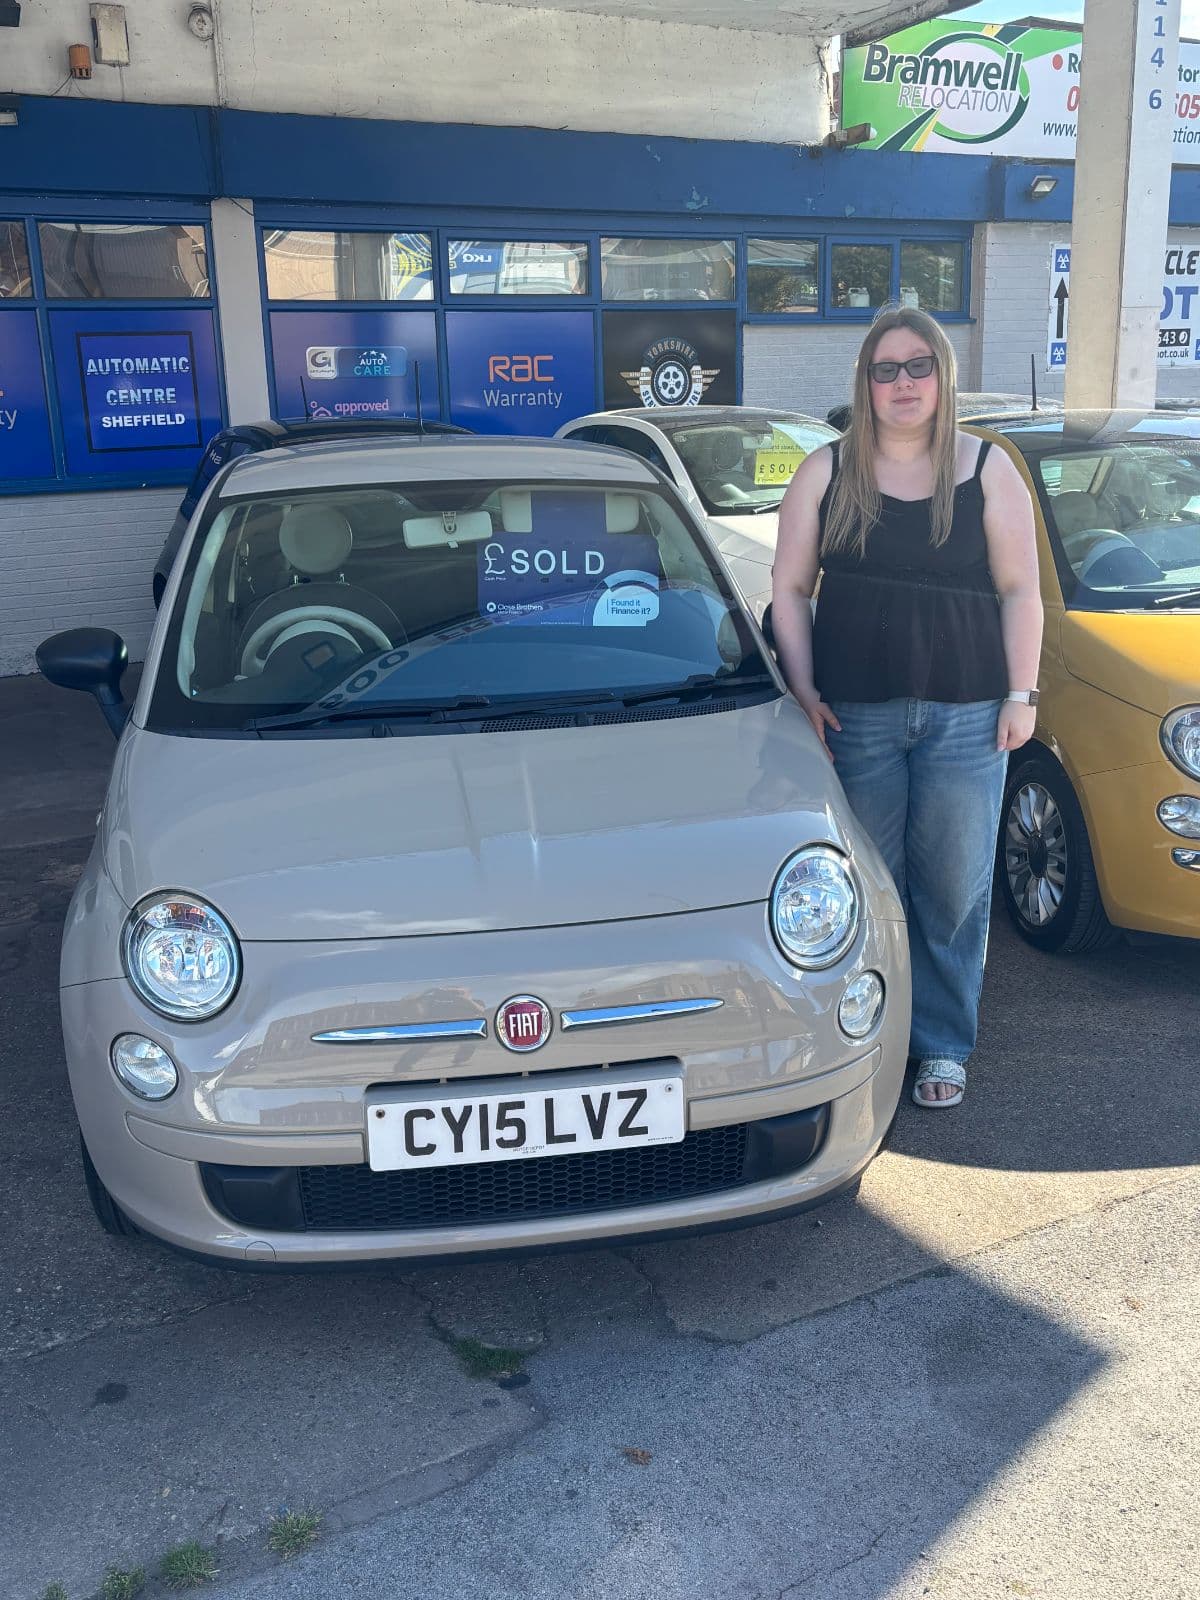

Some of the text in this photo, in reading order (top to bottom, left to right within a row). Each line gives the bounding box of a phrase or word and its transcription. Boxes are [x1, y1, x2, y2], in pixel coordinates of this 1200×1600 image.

[863, 43, 1023, 91] Bramwell
[898, 86, 1013, 113] RELOCATION
[1164, 250, 1200, 275] CLE
[647, 340, 696, 359] YORKSHIRE
[87, 357, 190, 375] AUTOMATIC
[353, 366, 391, 375] CARE
[360, 358, 384, 366] AUTO
[106, 388, 177, 405] CENTRE
[483, 388, 562, 408] Warranty
[334, 399, 389, 416] approved
[102, 413, 185, 428] SHEFFIELD
[611, 599, 640, 607] Found it
[611, 607, 651, 615] Finance it?
[509, 1012, 539, 1038] FIAT
[403, 1088, 649, 1157] CY15 LVZ
